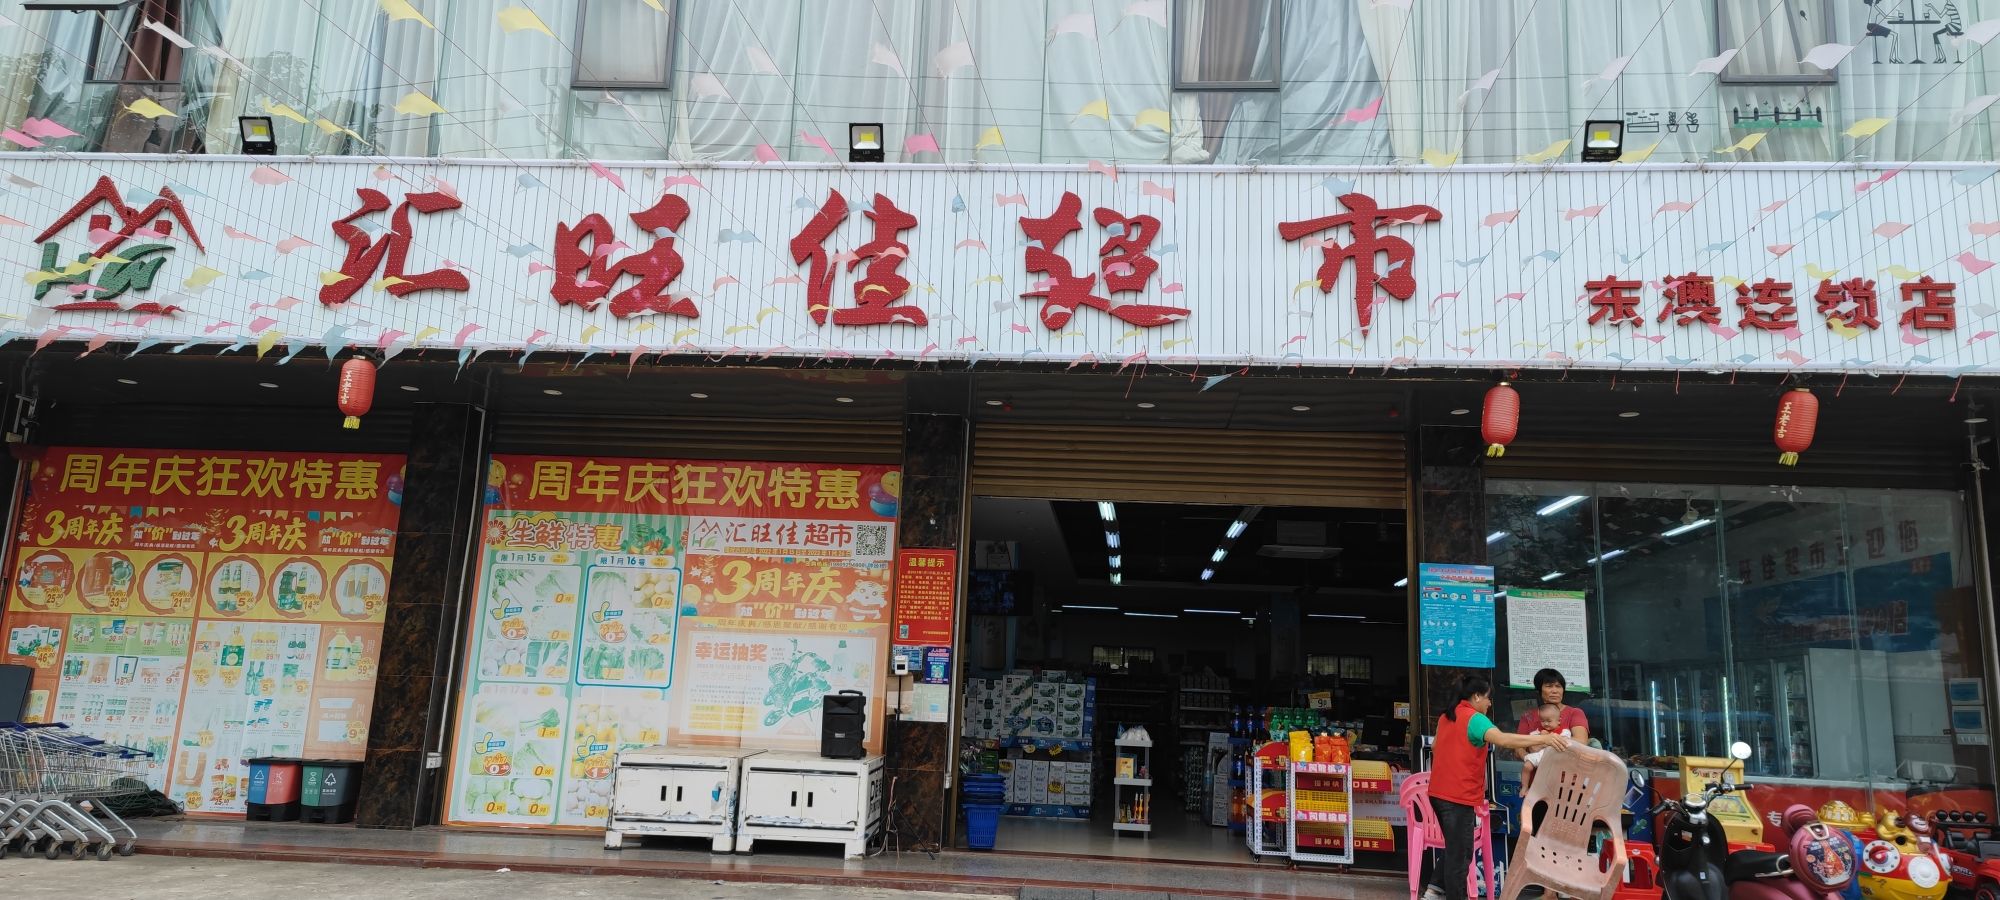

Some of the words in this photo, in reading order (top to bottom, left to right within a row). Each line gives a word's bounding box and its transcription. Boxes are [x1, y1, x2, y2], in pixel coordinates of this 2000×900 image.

[318, 188, 1443, 338] 汇旺佳超市
[1583, 270, 1957, 331] 东澳连锁店
[1777, 402, 1793, 438] 王老吉
[58, 453, 382, 501] 周年庆狂欢特惠
[529, 460, 861, 510] 周年庆狂欢特惠
[37, 509, 124, 547] 3周年庆
[218, 514, 307, 552] 3周年庆
[506, 518, 624, 550] 生鲜特惠
[725, 521, 854, 548] 汇旺佳超市
[908, 557, 945, 568] 温馨提示
[713, 559, 844, 605] 3周年庆
[695, 641, 768, 663] 幸运抽奖
